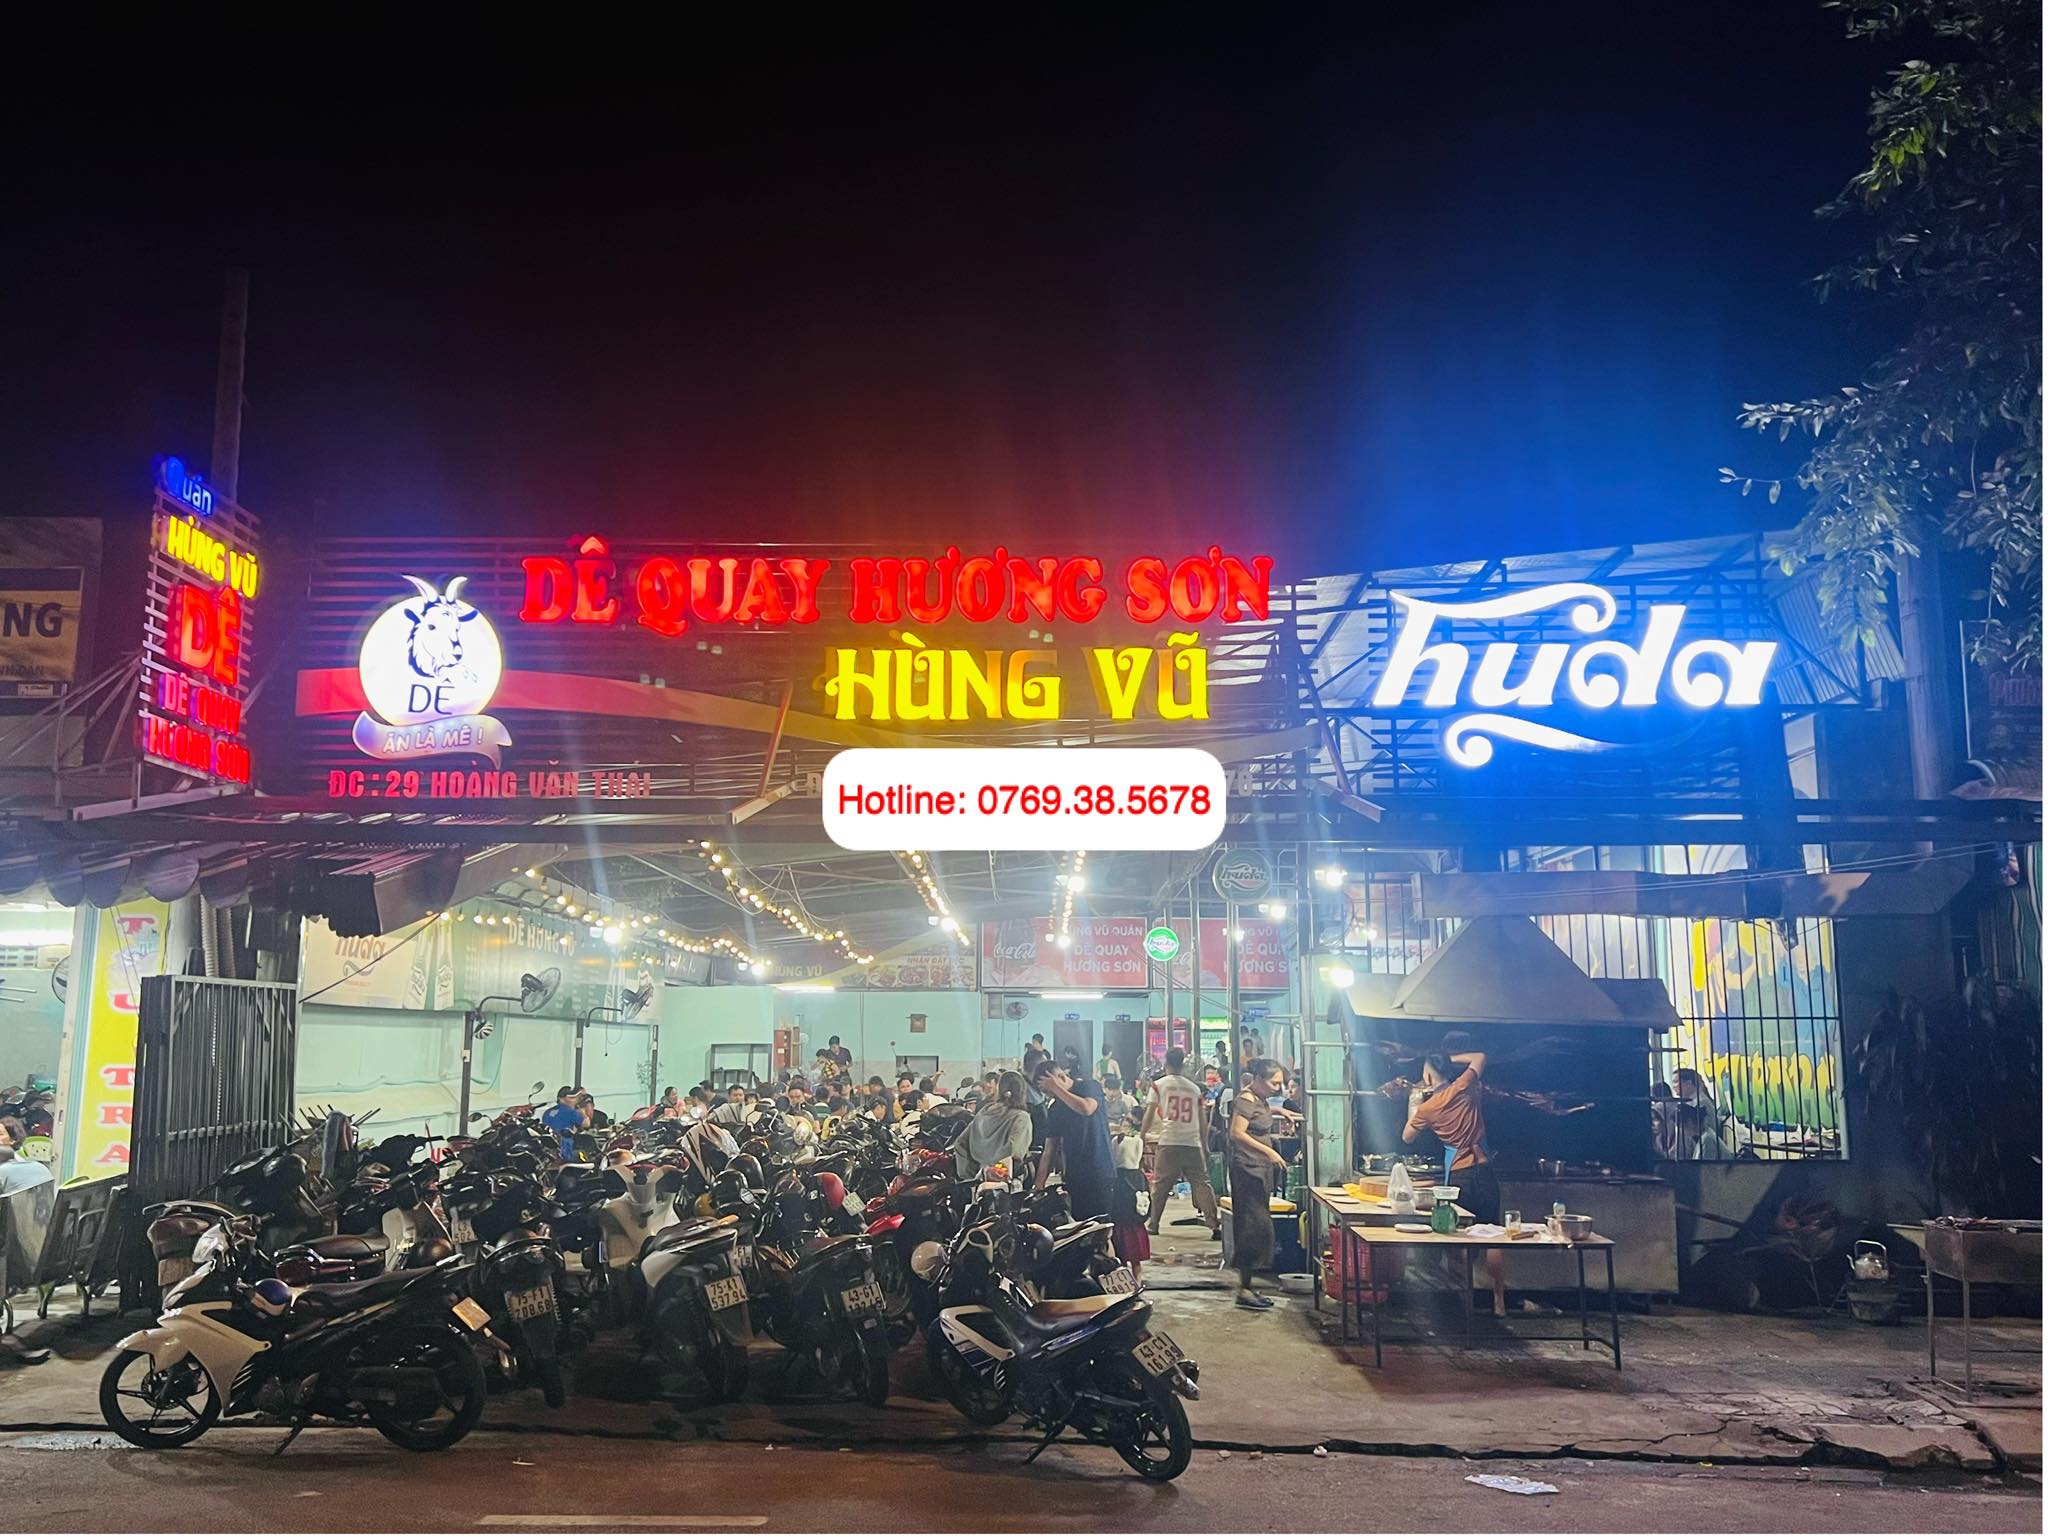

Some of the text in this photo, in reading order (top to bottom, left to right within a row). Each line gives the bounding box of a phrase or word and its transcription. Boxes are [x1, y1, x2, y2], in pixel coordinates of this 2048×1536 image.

[167, 515, 258, 599] HÙNG VŨ
[519, 535, 1274, 637] DÊ QUAY HƯƠNG SƠN
[178, 583, 241, 687] DÊ
[824, 630, 1209, 720] HÙNG VŨ
[1371, 581, 1779, 745] huda
[408, 677, 455, 715] DÊ
[415, 726, 435, 749] LÀ
[442, 725, 471, 747] MÊ
[430, 760, 517, 798] HOÀNG
[529, 760, 580, 798] VĂN
[1095, 944, 1130, 957] QUAY
[1113, 959, 1142, 973] SƠN
[1168, 1096, 1193, 1124] 39
[1139, 1336, 1168, 1359] 43-C1
